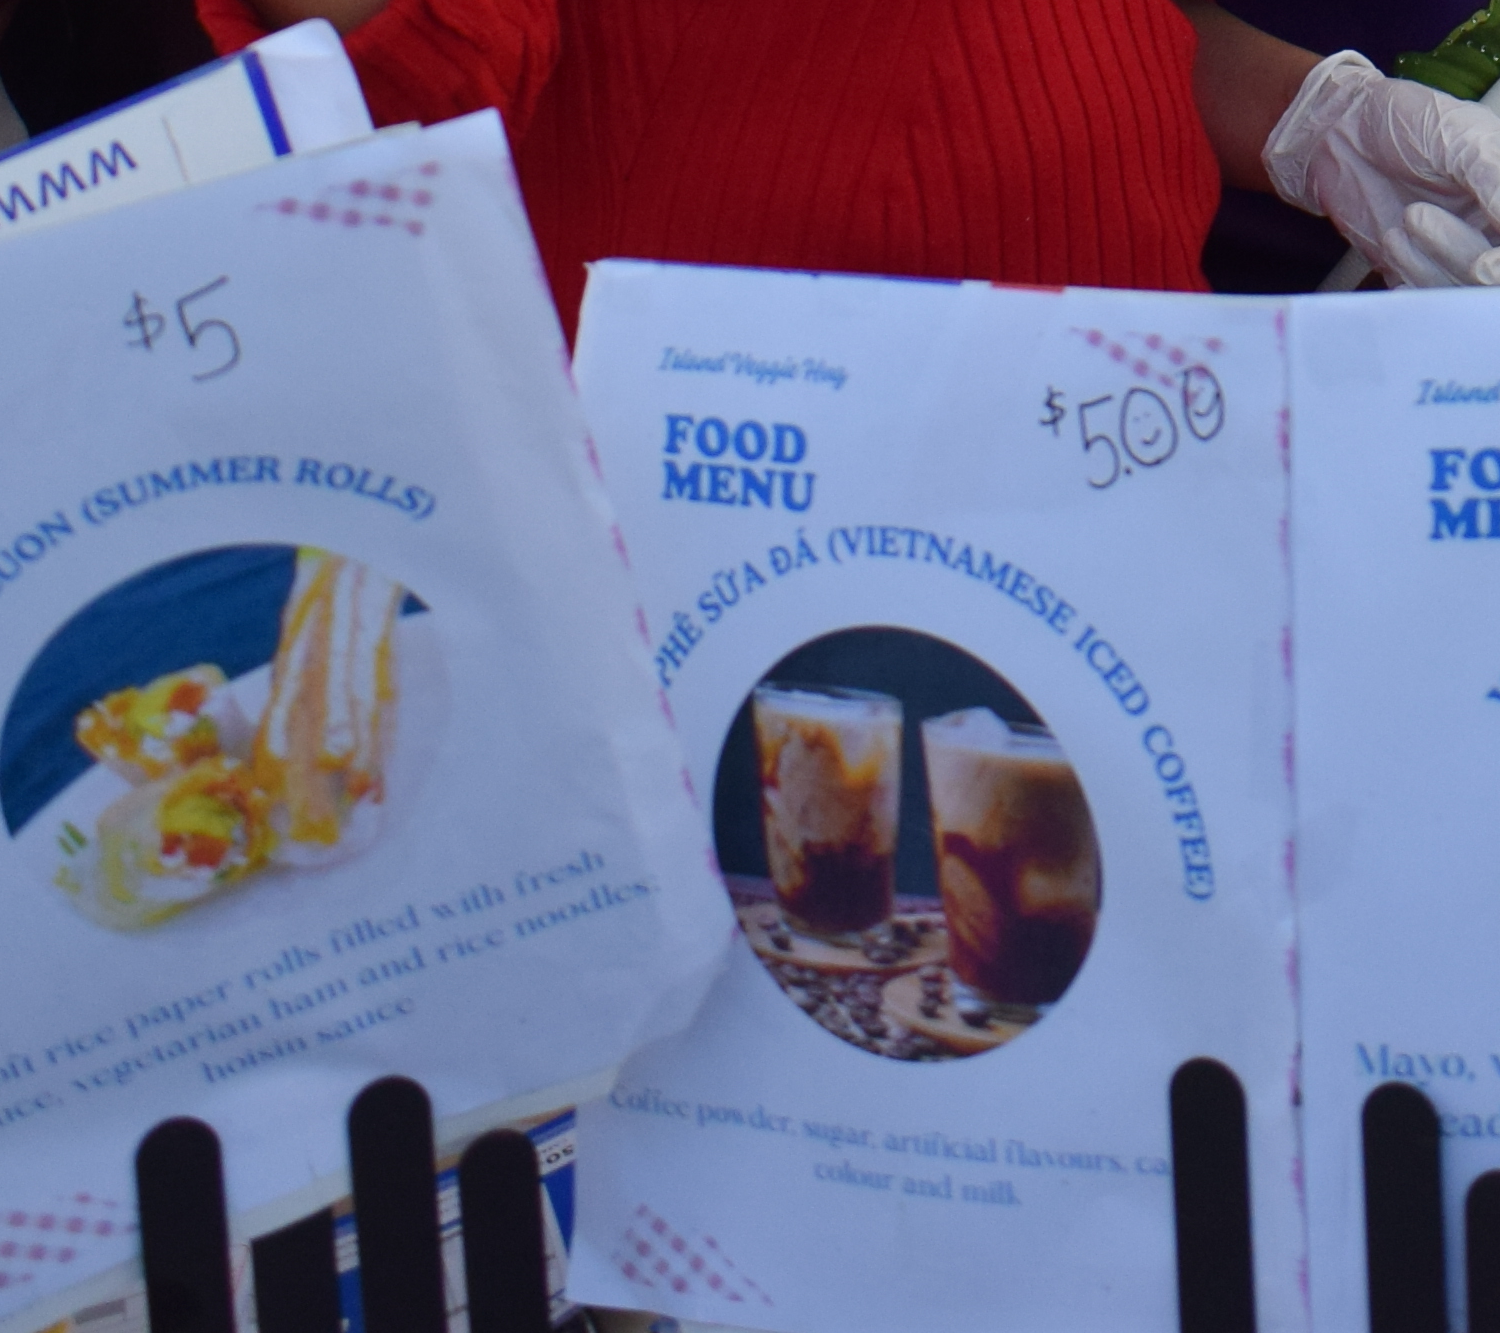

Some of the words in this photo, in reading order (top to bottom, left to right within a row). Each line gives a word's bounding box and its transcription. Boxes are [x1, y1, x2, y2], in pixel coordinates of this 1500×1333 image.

[122, 273, 242, 382] $5
[1415, 377, 1500, 408] Island
[664, 413, 806, 465] FOOD
[80, 455, 281, 526] (SUMMER
[292, 457, 437, 522] ROLLS)
[662, 459, 817, 513] MENU
[828, 525, 1077, 637] (VIETNAMESE
[1073, 626, 1152, 719] ICED
[1142, 723, 1216, 903] COFFEE)
[45, 1026, 115, 1064] rice
[125, 981, 232, 1039] paper
[243, 946, 322, 990] rolls
[330, 904, 420, 954] filled
[431, 883, 506, 919] with
[514, 848, 605, 897] fresh
[71, 1013, 263, 1092] vegetarian
[267, 979, 348, 1021] ham
[357, 946, 426, 986] and
[436, 929, 504, 964] rice
[202, 1035, 308, 1083] hoisin
[316, 997, 415, 1045] sauce
[1355, 1042, 1476, 1086] Mayo,
